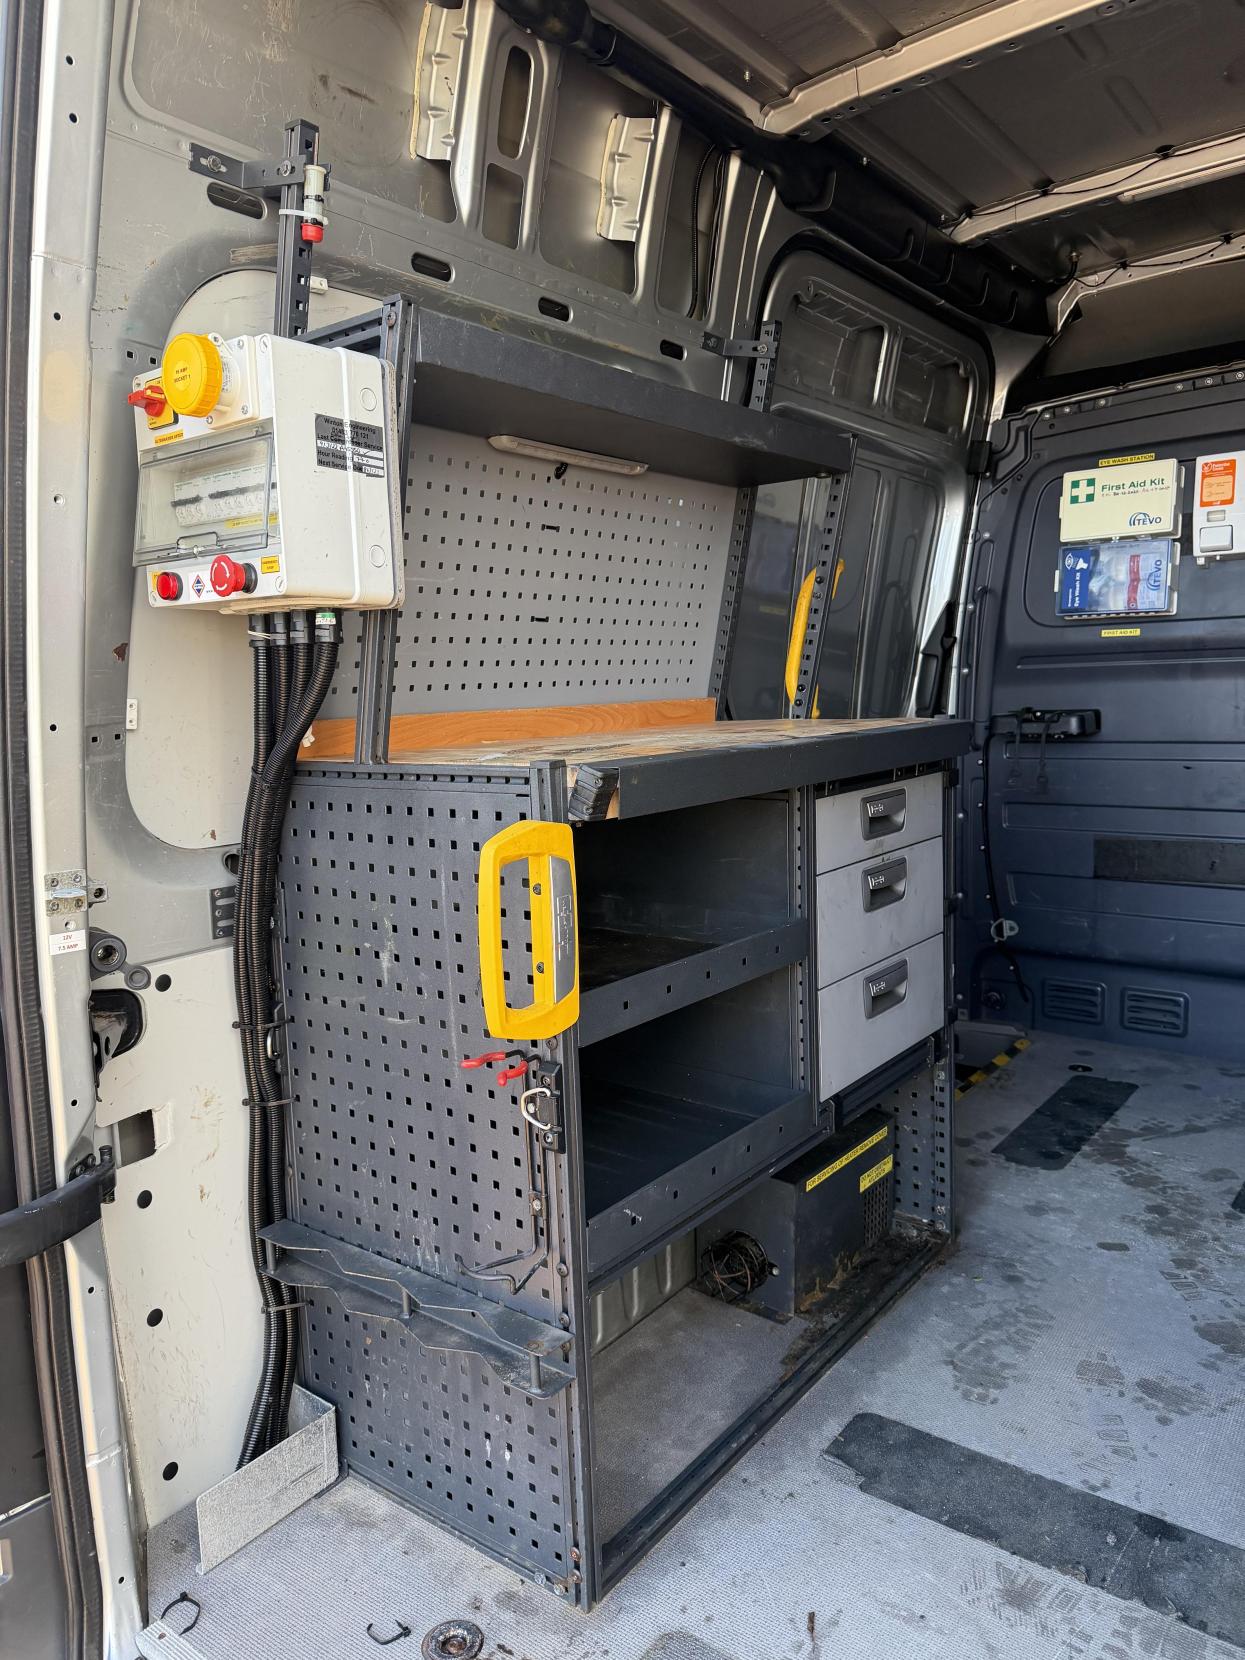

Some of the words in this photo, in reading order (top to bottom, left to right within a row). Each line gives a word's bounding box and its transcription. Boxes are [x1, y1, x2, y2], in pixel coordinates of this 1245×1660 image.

[1112, 456, 1129, 464] WASH
[1130, 454, 1154, 462] STATION
[1101, 482, 1125, 493] First
[1128, 479, 1146, 489] Aid
[1150, 477, 1165, 487] Kit
[807, 1177, 817, 1189] FOR
[816, 1164, 838, 1181] SERVICING
